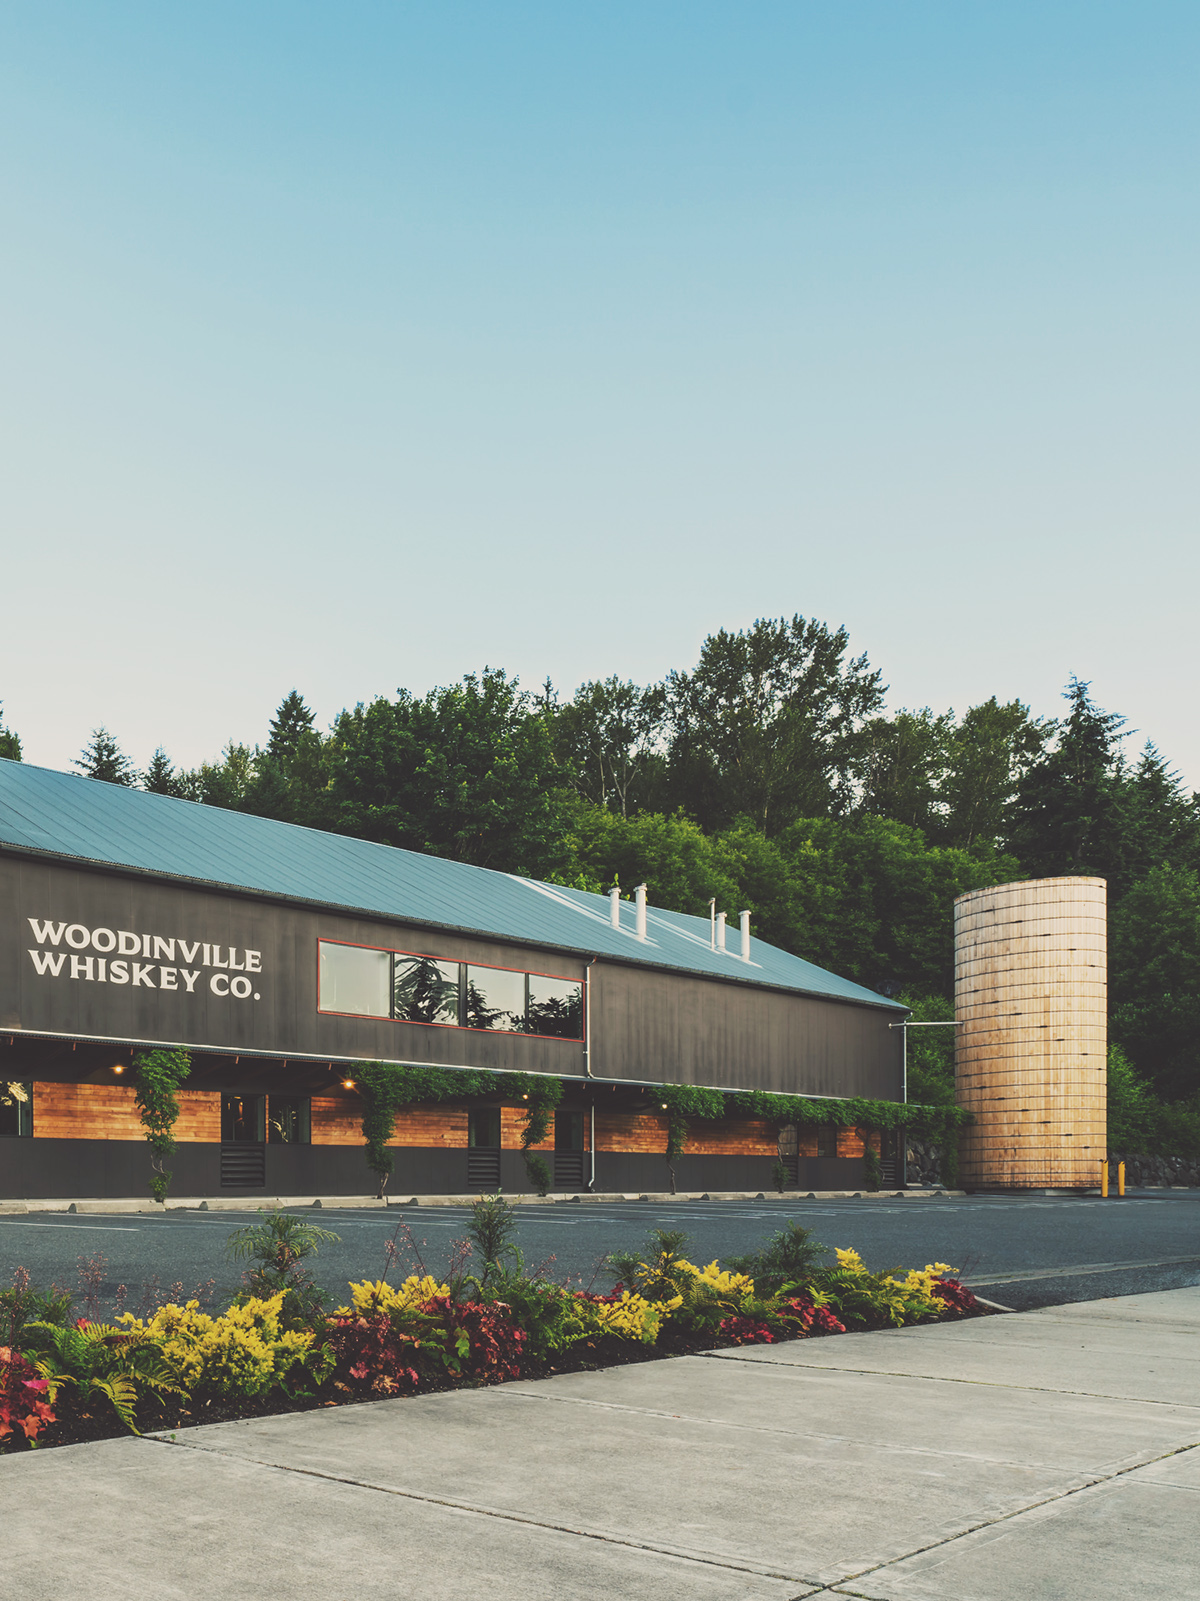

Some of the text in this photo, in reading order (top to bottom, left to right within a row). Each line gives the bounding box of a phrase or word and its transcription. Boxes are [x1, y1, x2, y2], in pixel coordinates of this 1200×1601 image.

[27, 917, 262, 973] WOODINVILLE
[27, 949, 261, 1000] WHISKEY CO.
